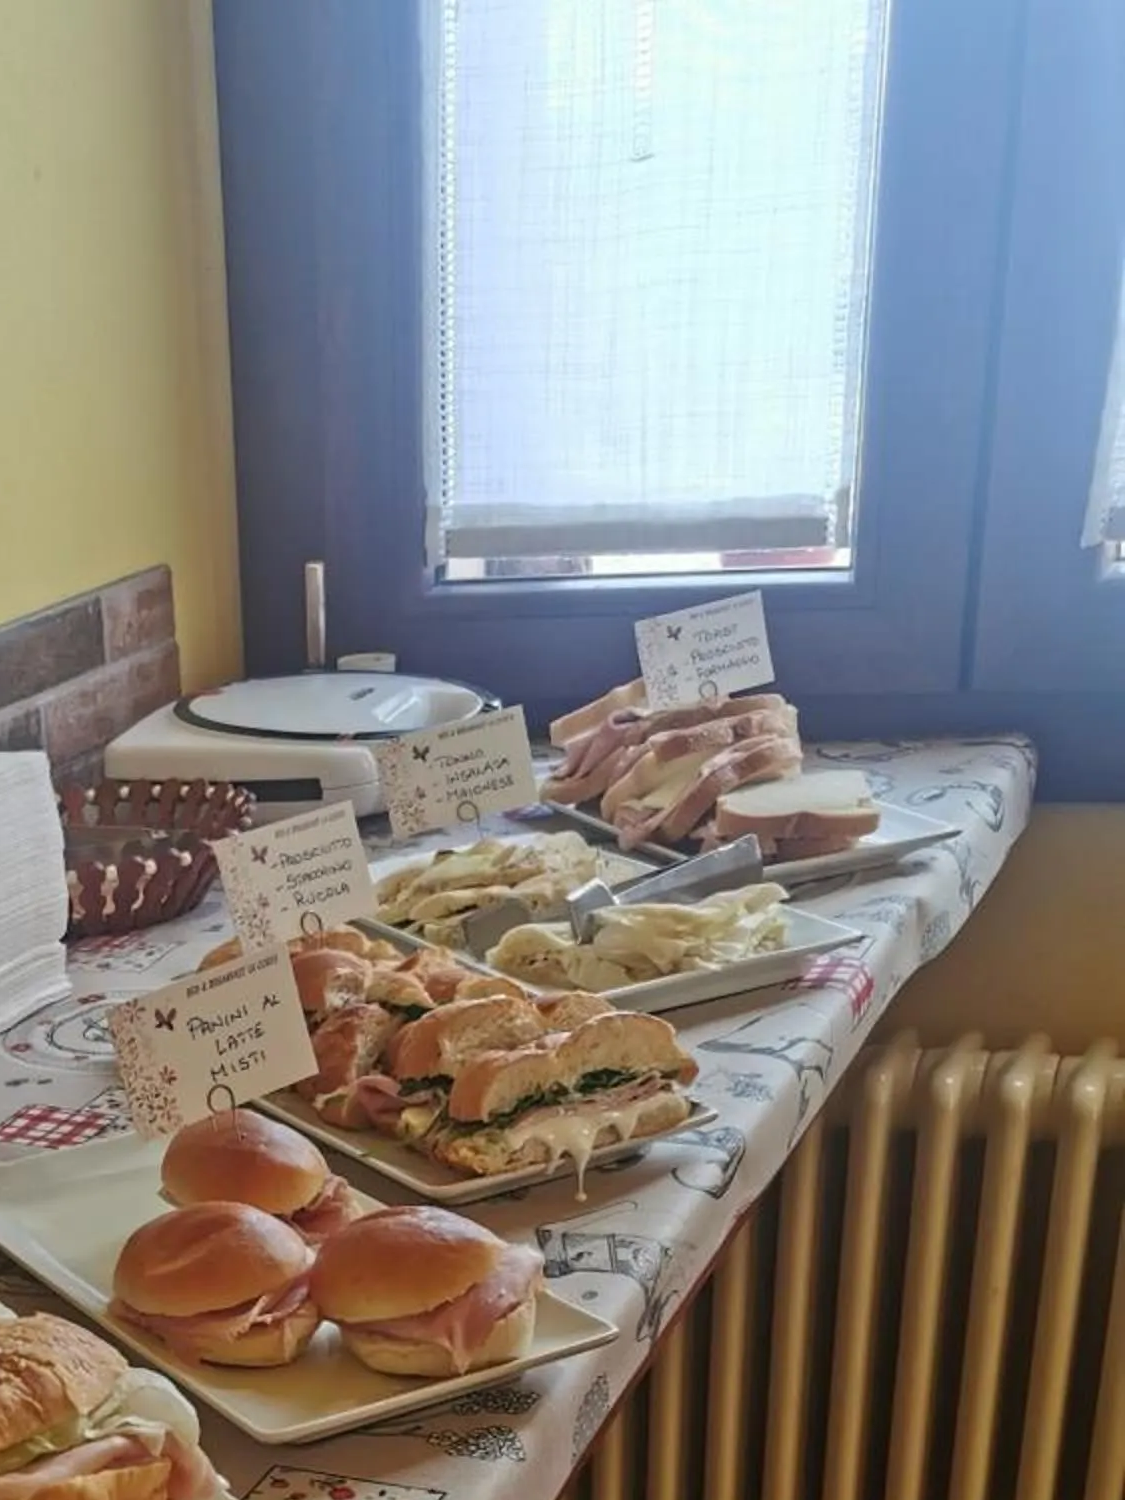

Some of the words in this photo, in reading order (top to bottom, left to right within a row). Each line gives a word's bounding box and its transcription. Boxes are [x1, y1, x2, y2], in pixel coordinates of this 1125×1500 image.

[292, 882, 350, 907] RUCOLA
[186, 1004, 249, 1040] PANINI
[262, 994, 281, 1012] AL
[214, 1022, 266, 1056] LATTE
[210, 1051, 266, 1082] MISTI
